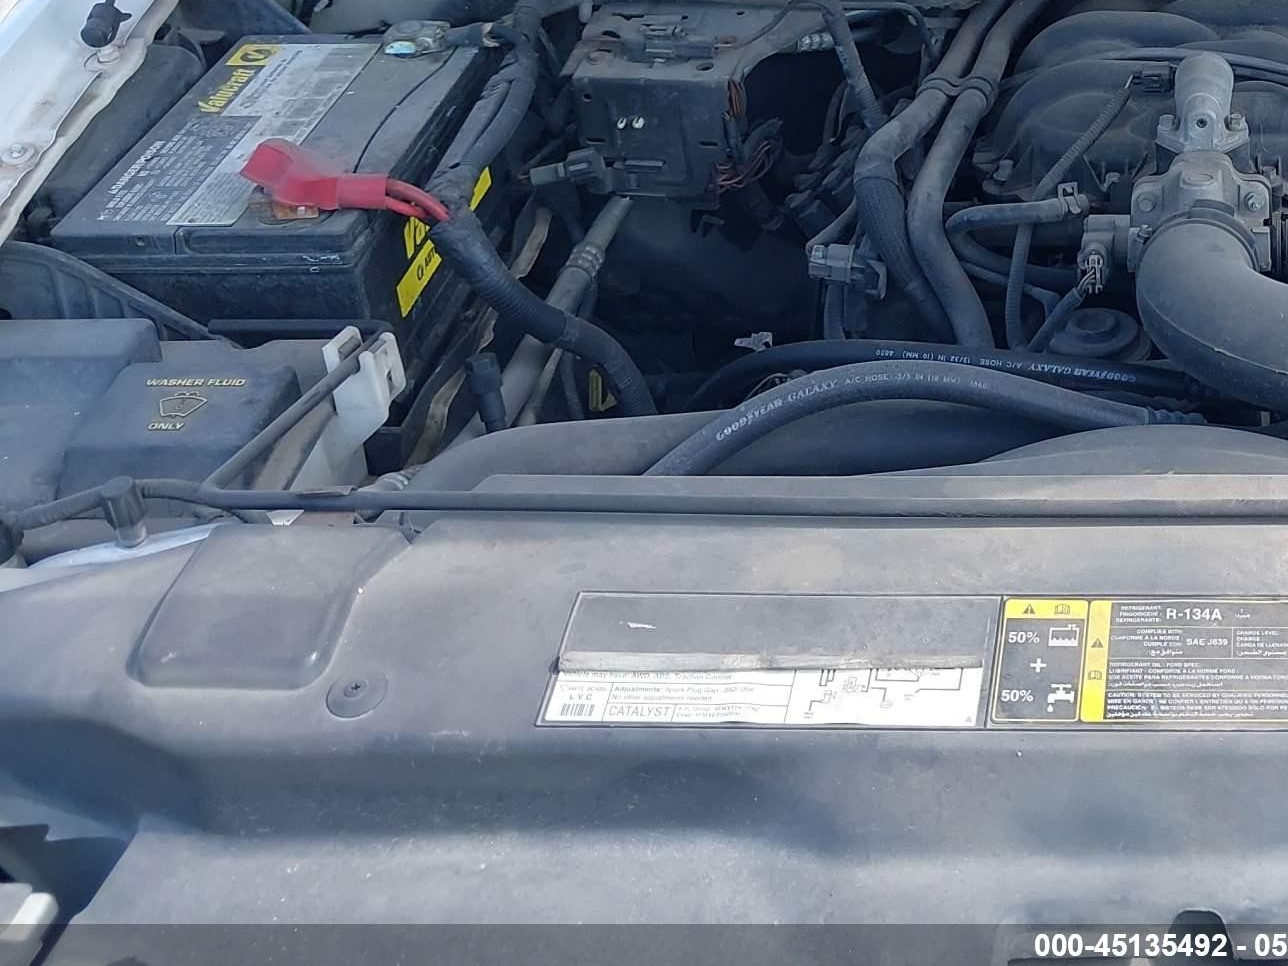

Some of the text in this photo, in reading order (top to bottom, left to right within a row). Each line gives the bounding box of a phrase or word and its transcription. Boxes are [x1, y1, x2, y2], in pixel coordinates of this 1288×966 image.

[980, 358, 1002, 367] HOSE
[1006, 361, 1023, 370] A/C
[1027, 363, 1071, 375] GALAXY
[1074, 367, 1137, 383] GOODYEAR
[146, 378, 247, 387] WASHER FLUID
[716, 398, 783, 441] GOODYEAR
[787, 379, 839, 403] GALAXY
[864, 373, 889, 383] HOSE
[148, 422, 186, 431] ONLY
[1165, 607, 1223, 622] R-134A
[1008, 631, 1040, 643] 50%
[1186, 638, 1206, 646] SAE
[1001, 689, 1034, 702] 50%
[609, 706, 672, 717] CATALYST
